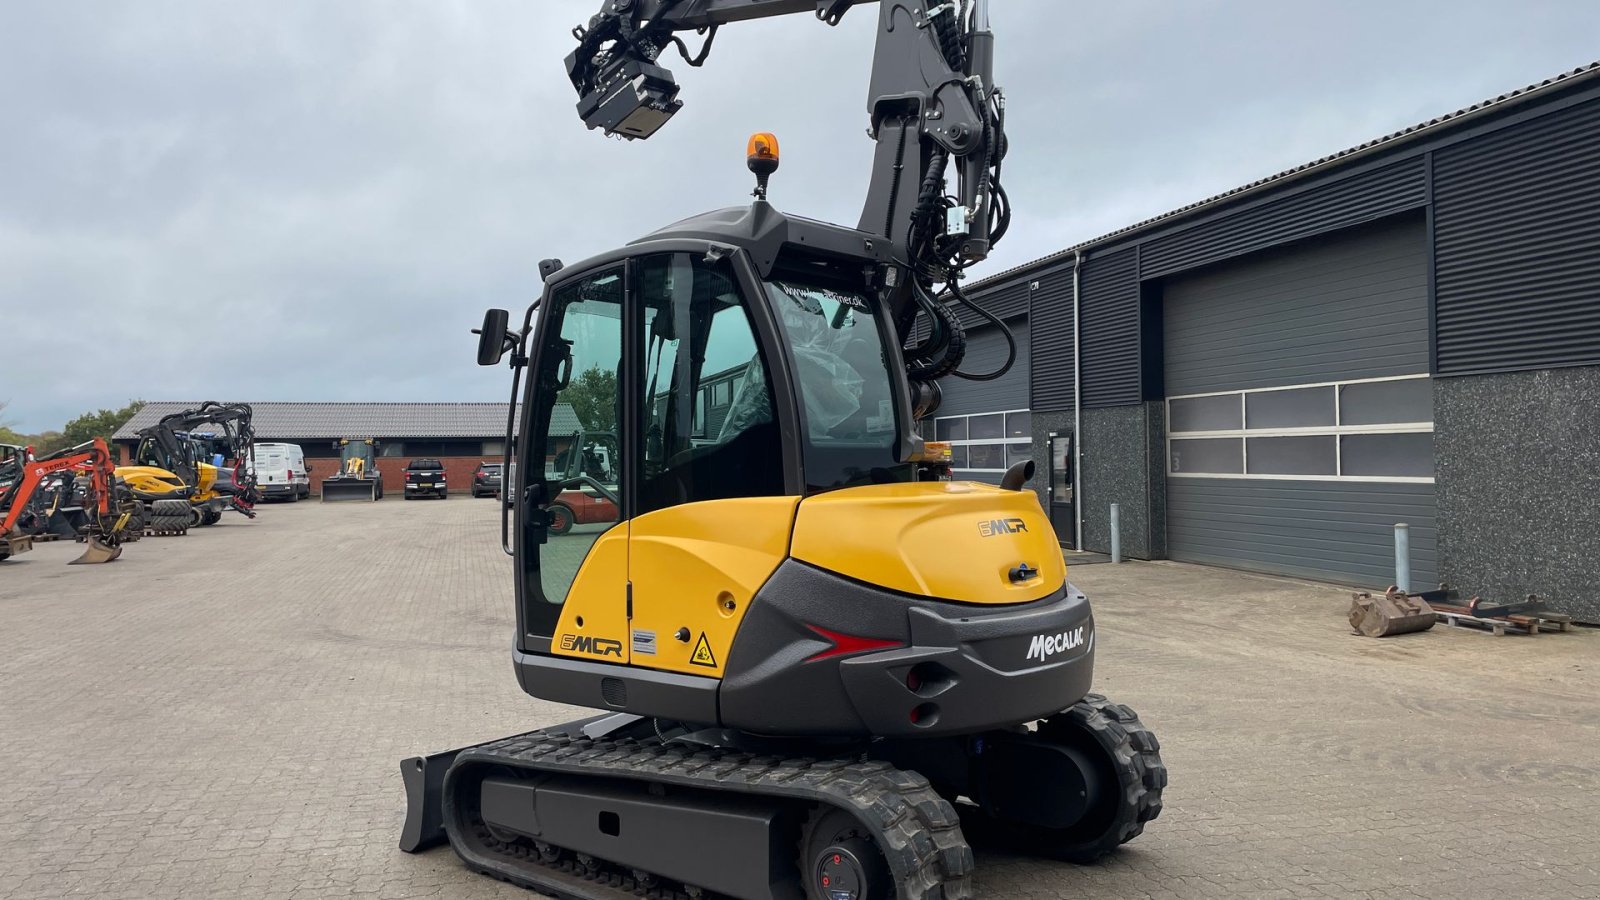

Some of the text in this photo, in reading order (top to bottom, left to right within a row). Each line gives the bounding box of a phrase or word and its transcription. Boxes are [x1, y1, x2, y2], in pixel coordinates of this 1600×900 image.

[45, 461, 70, 472] TEREX
[978, 518, 1029, 538] 6MCR
[559, 633, 623, 658] 6MCR
